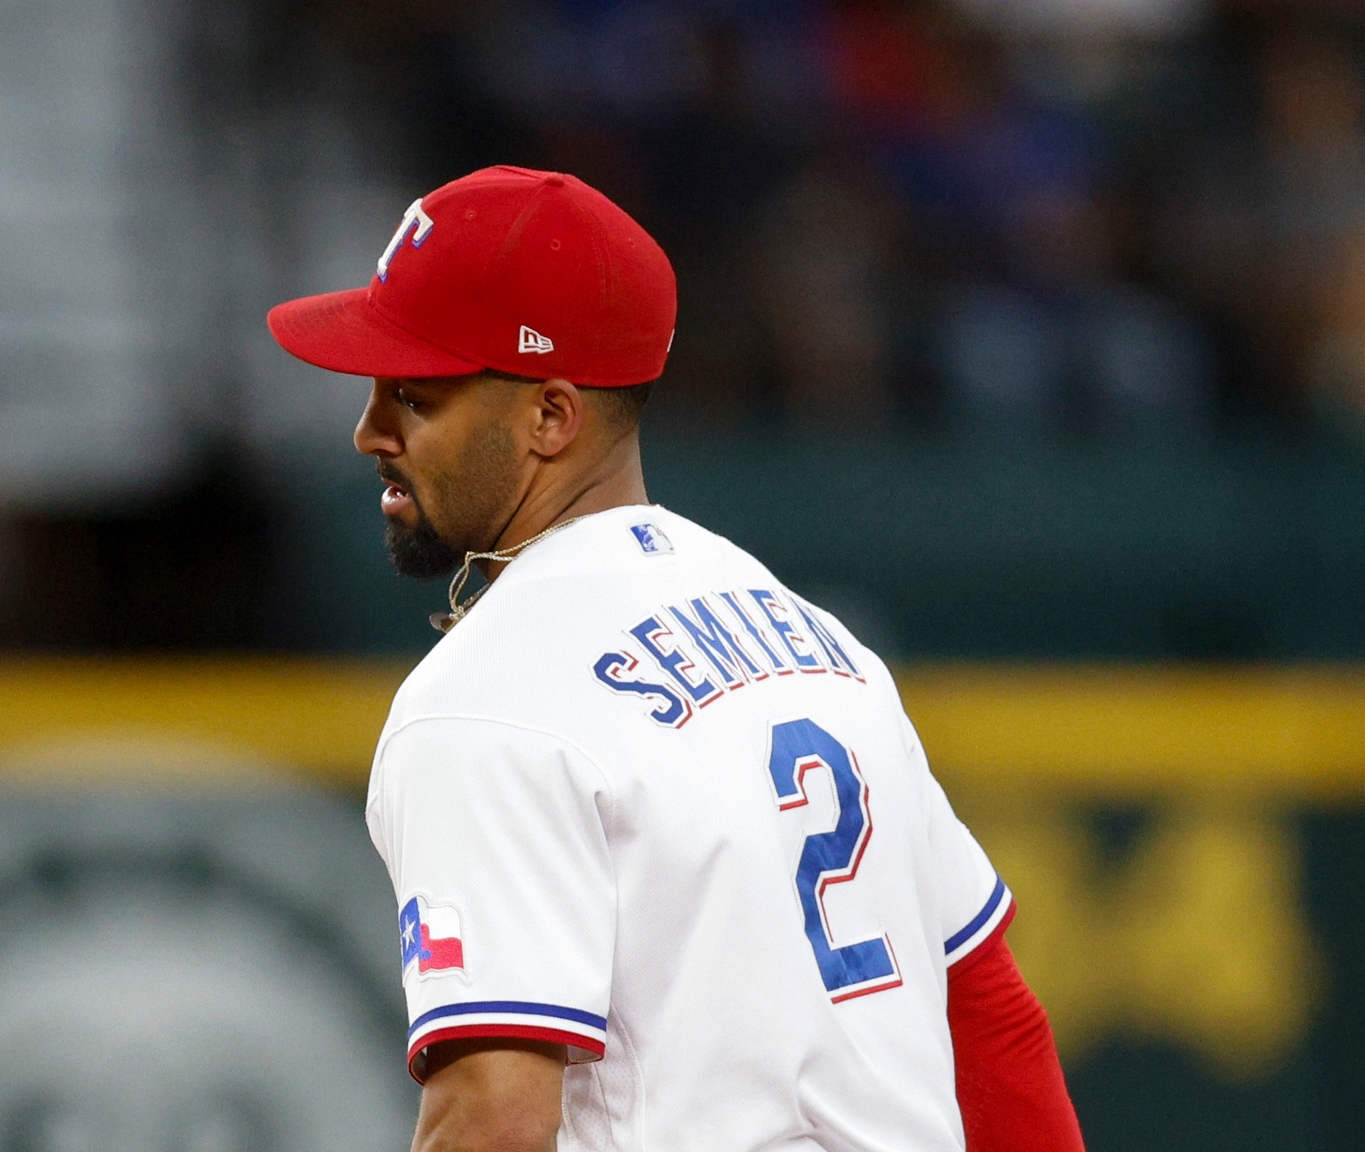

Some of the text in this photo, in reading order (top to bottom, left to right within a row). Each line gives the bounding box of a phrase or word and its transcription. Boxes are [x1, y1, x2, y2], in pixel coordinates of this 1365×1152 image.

[376, 198, 434, 283] T
[588, 588, 866, 729] SEMIEN
[768, 717, 903, 1004] 2
